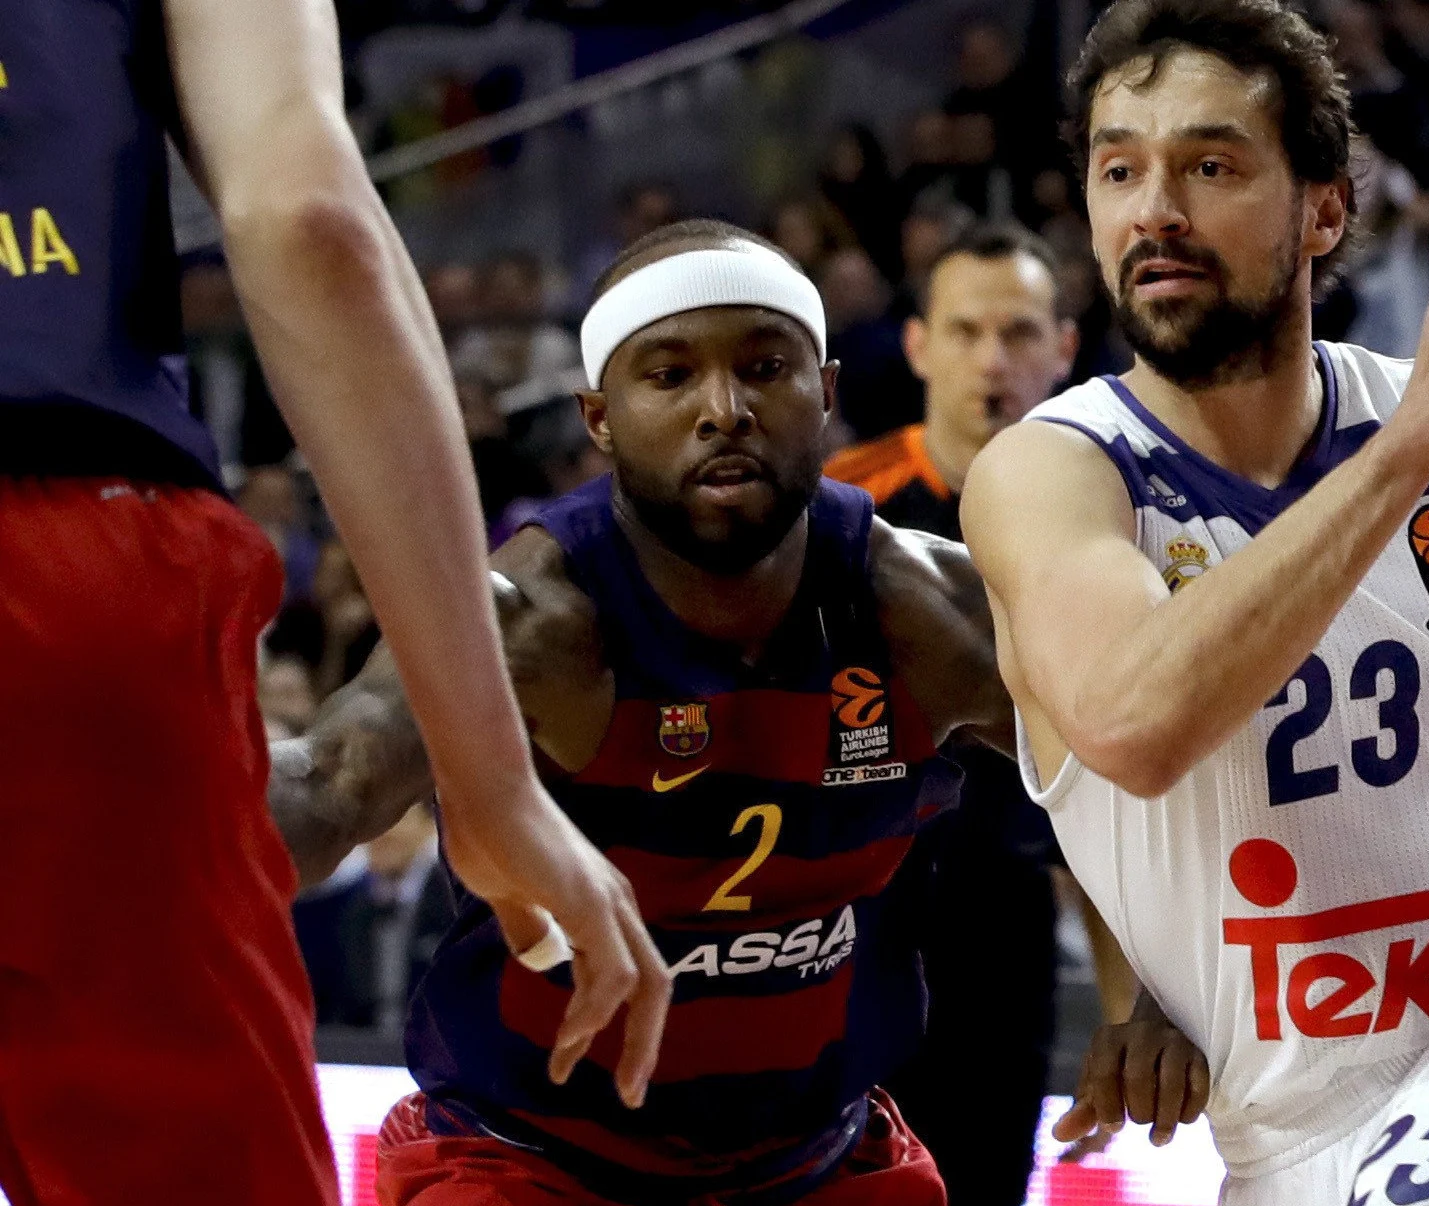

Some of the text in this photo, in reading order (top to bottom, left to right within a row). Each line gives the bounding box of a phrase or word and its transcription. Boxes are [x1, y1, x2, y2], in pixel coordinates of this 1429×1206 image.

[839, 725, 889, 742] TURKISH
[841, 735, 889, 753] AIRLINES
[1264, 639, 1421, 808] 23
[702, 803, 783, 912] 2
